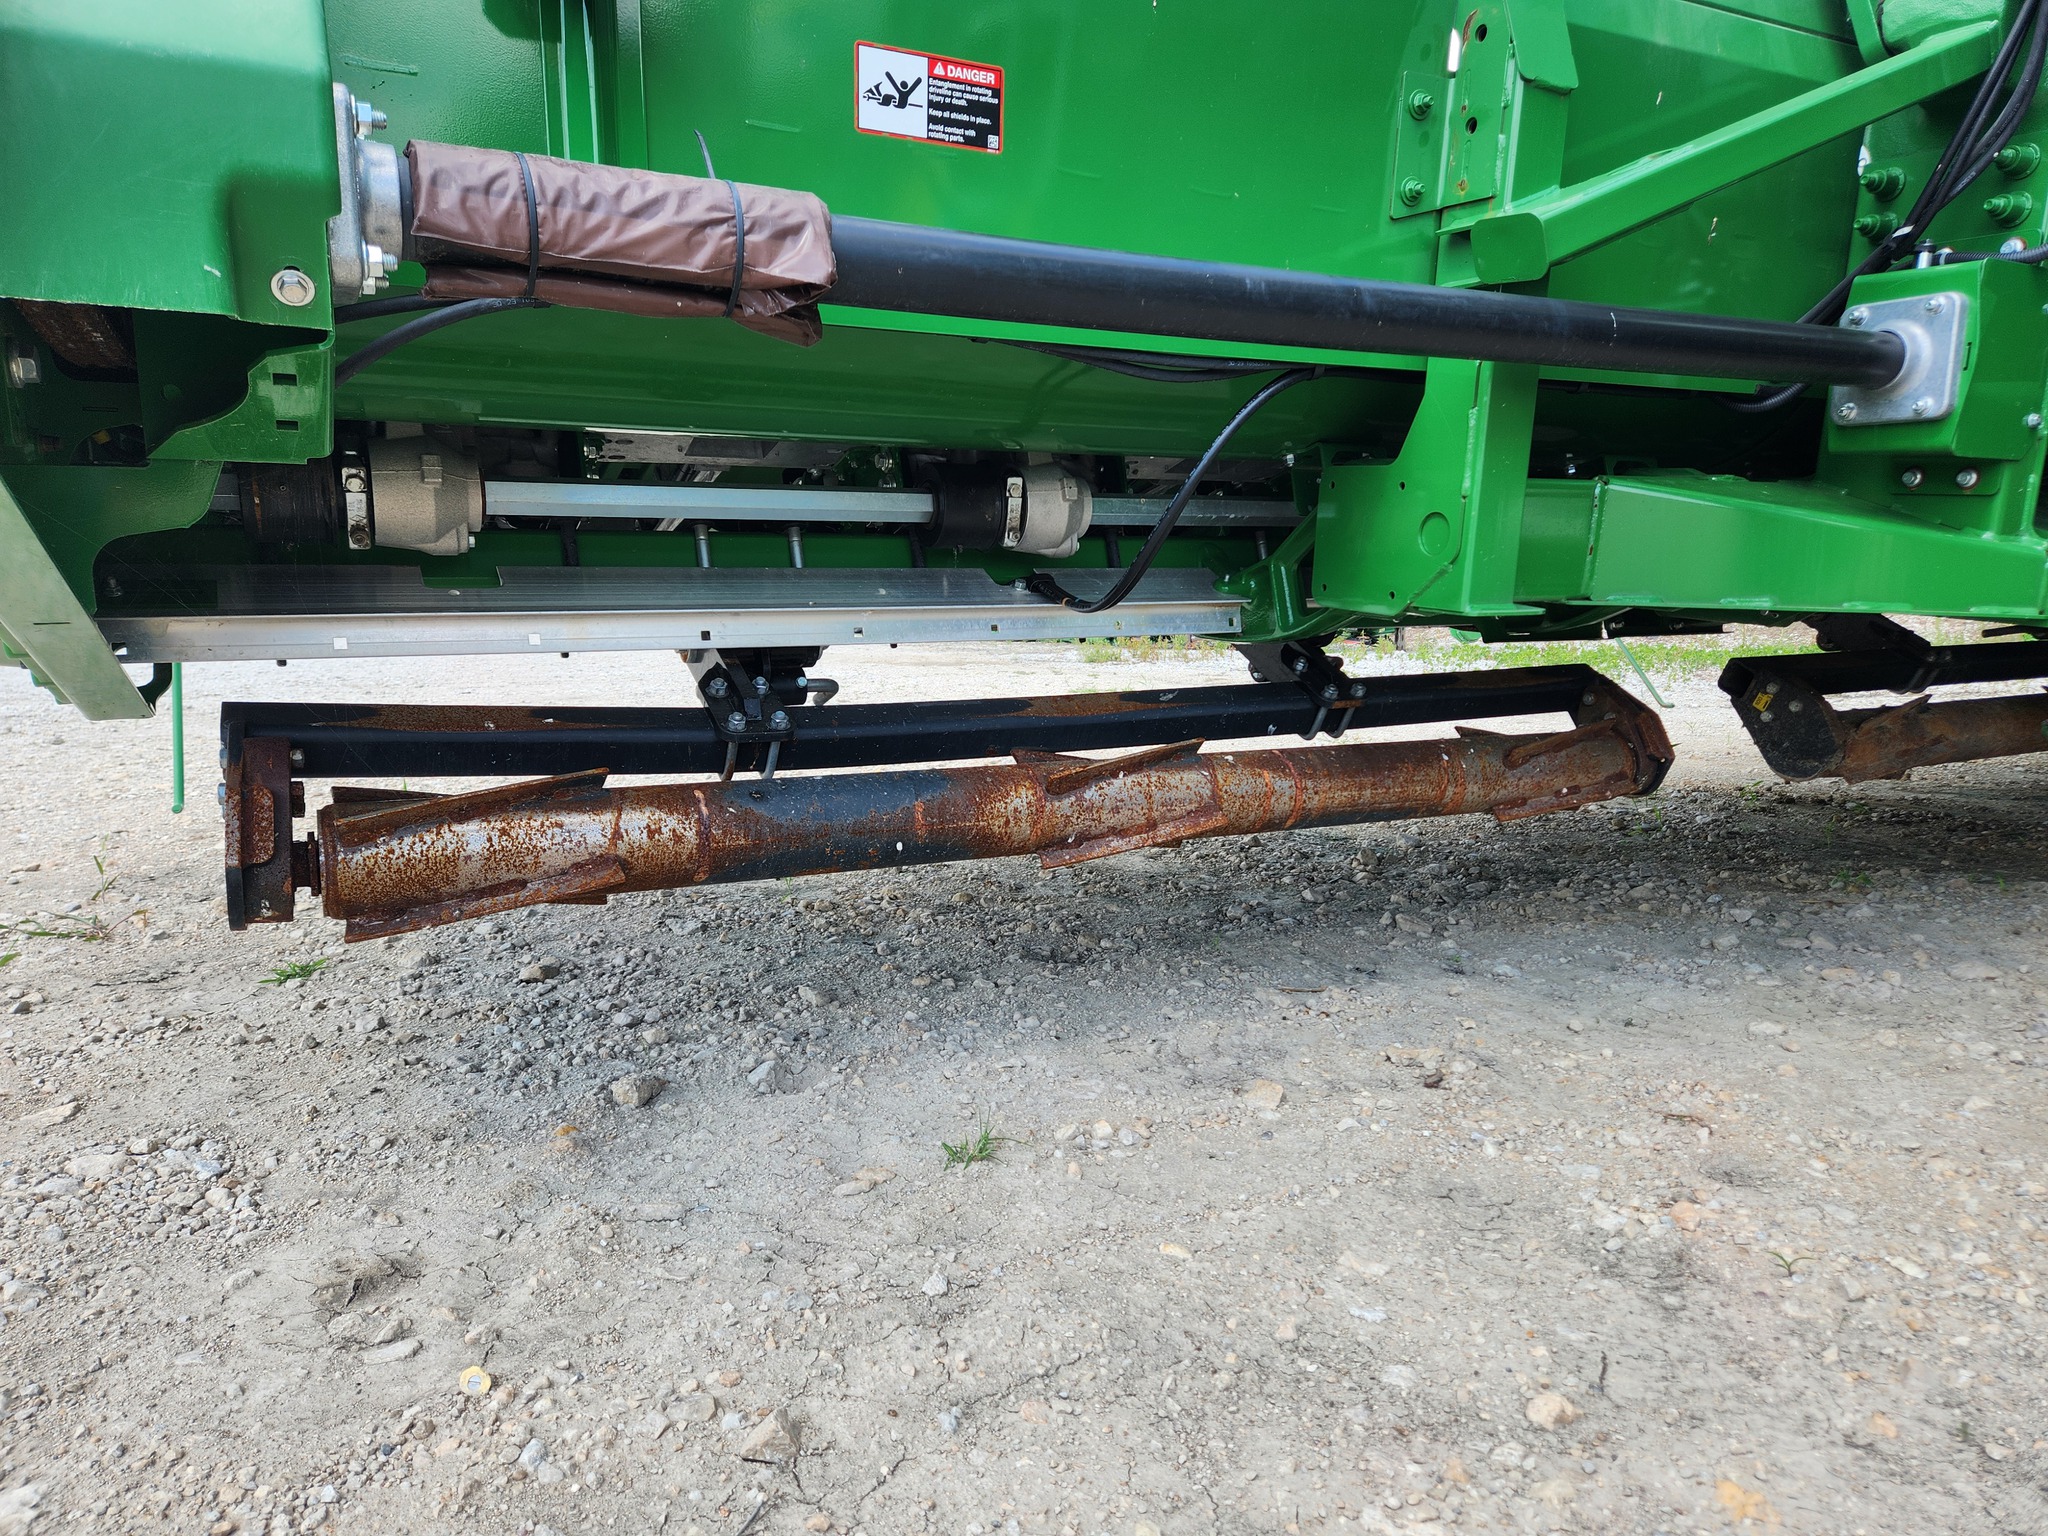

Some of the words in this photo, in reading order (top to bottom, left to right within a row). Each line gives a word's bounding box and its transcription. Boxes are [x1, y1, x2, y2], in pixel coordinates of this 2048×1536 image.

[947, 65, 995, 85] DANGER
[929, 78, 965, 91] Entanglement
[966, 84, 971, 92] in
[972, 86, 992, 97] rotating
[929, 86, 952, 96] driveline
[963, 92, 979, 101] cause
[979, 95, 999, 104] serious
[952, 97, 968, 107] death.
[929, 108, 943, 118] Keep
[951, 112, 970, 122] shields
[976, 116, 992, 125] place.
[929, 123, 944, 132] Avoid
[944, 126, 965, 135] contact
[965, 129, 976, 137] with
[929, 131, 949, 142] rotating
[950, 134, 965, 143] parts.
